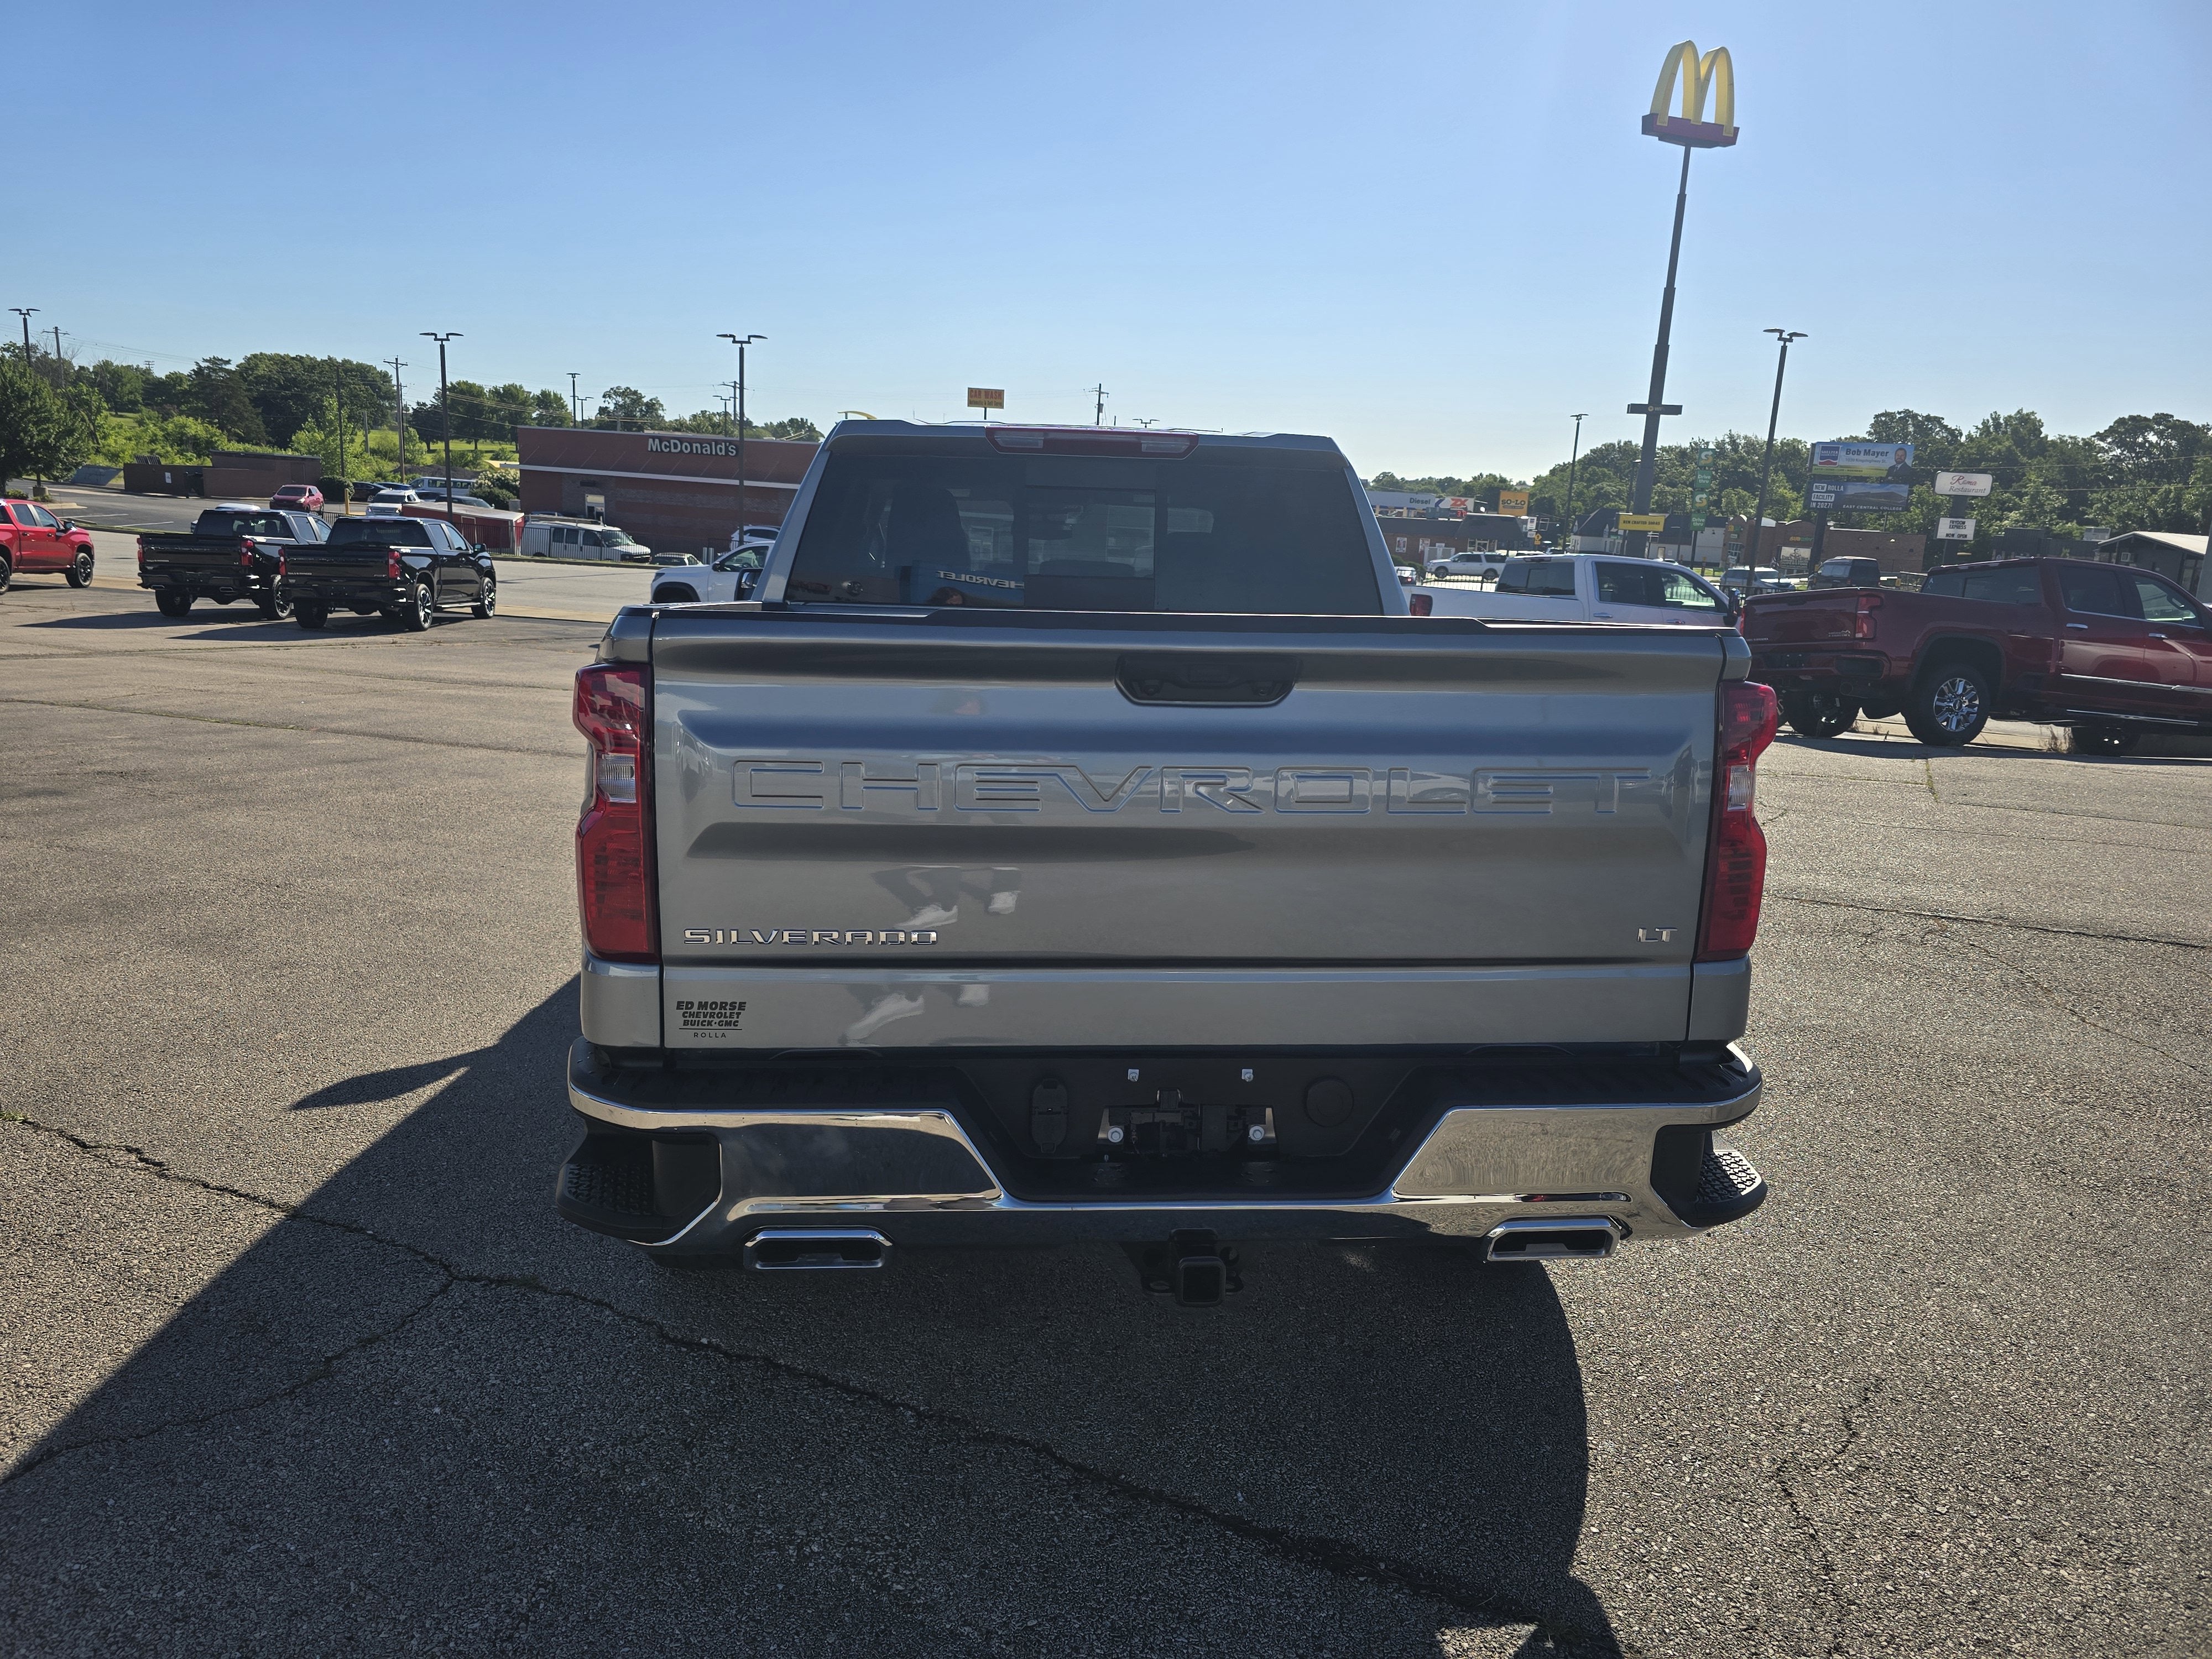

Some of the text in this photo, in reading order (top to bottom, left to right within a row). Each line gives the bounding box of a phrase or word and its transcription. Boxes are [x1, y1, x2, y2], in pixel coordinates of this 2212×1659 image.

[970, 389, 1003, 400] CAR WASH
[648, 438, 737, 456] McDonald's
[1864, 448, 1889, 458] Mayer
[1950, 475, 1977, 486] Roma
[1450, 498, 1469, 507] ZX
[731, 760, 1653, 815] CHEVROLET
[684, 928, 938, 946] SILVERADO
[1637, 927, 1678, 942] LT
[676, 1001, 747, 1011] ED MORSE
